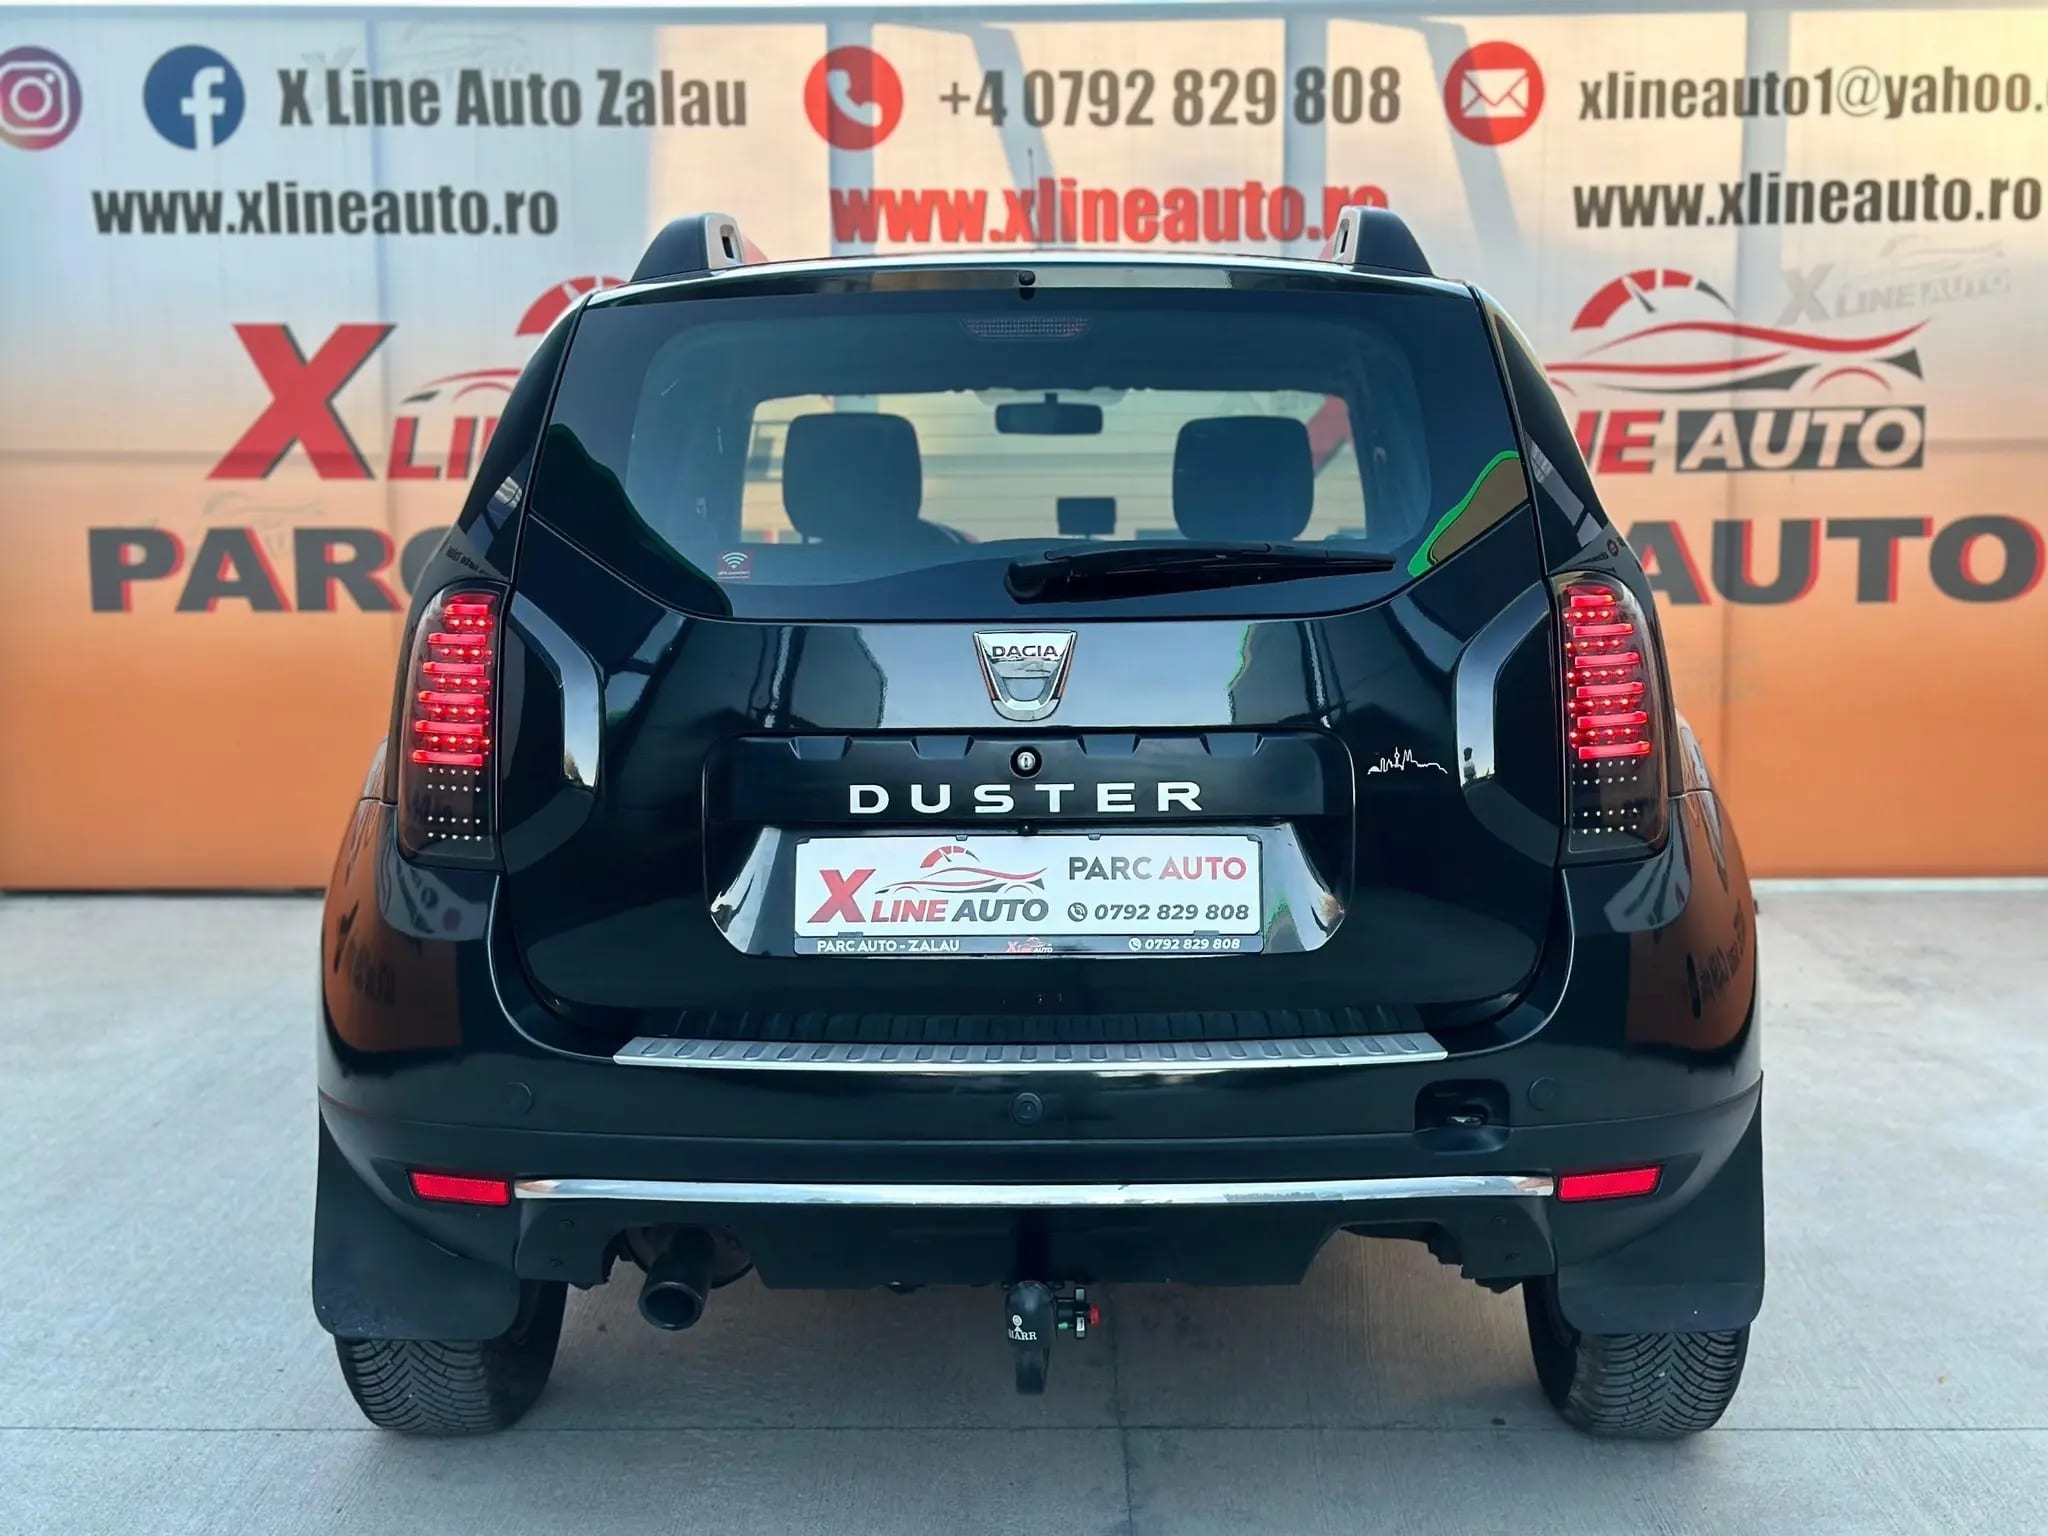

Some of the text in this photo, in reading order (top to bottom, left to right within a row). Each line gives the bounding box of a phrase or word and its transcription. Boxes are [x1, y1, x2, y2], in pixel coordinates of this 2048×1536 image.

[277, 68, 747, 128] X Line Auto Zalau
[940, 66, 1400, 128] +4 0792 829 808
[1580, 65, 2048, 120] xlineauto1@yahoo.
[91, 180, 559, 236] www.xlineauto.ro
[1573, 171, 2042, 228] www.xlineauto.ro
[205, 323, 397, 480] X
[1679, 407, 1923, 470] AUTO
[1624, 513, 2047, 607] AUTO
[992, 645, 1059, 657] DACIA
[849, 781, 1203, 814] DUSTER
[1069, 856, 1247, 880] PARC AUTO
[807, 869, 1049, 923] X LINE AUTO
[1094, 904, 1249, 921] 0792 829 808
[817, 940, 855, 953] PARC
[856, 940, 897, 952] AUTO
[908, 939, 960, 952] ZALAU
[1144, 938, 1241, 950] 0792 829 808
